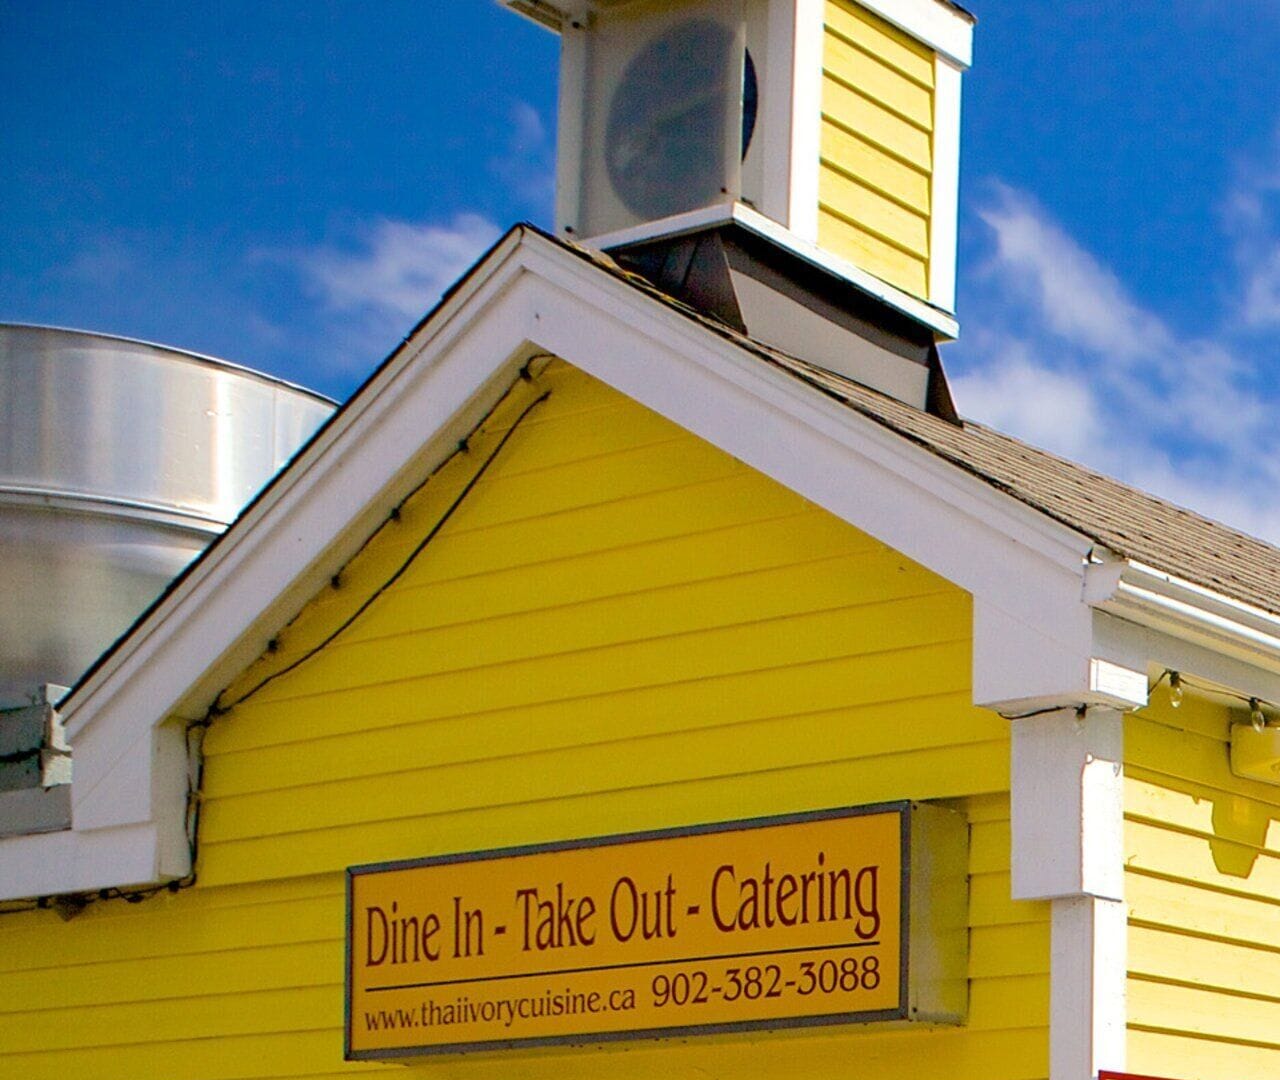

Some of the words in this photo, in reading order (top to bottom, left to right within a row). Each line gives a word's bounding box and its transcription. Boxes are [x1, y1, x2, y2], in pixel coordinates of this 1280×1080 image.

[365, 901, 441, 967] Dine
[452, 896, 485, 958] In
[516, 882, 597, 952] Take
[610, 873, 677, 943] Out
[711, 851, 881, 940] Catering
[364, 988, 636, 1031] www.thaiivorycuisine.ca
[652, 956, 881, 1008] 902-382-3088
